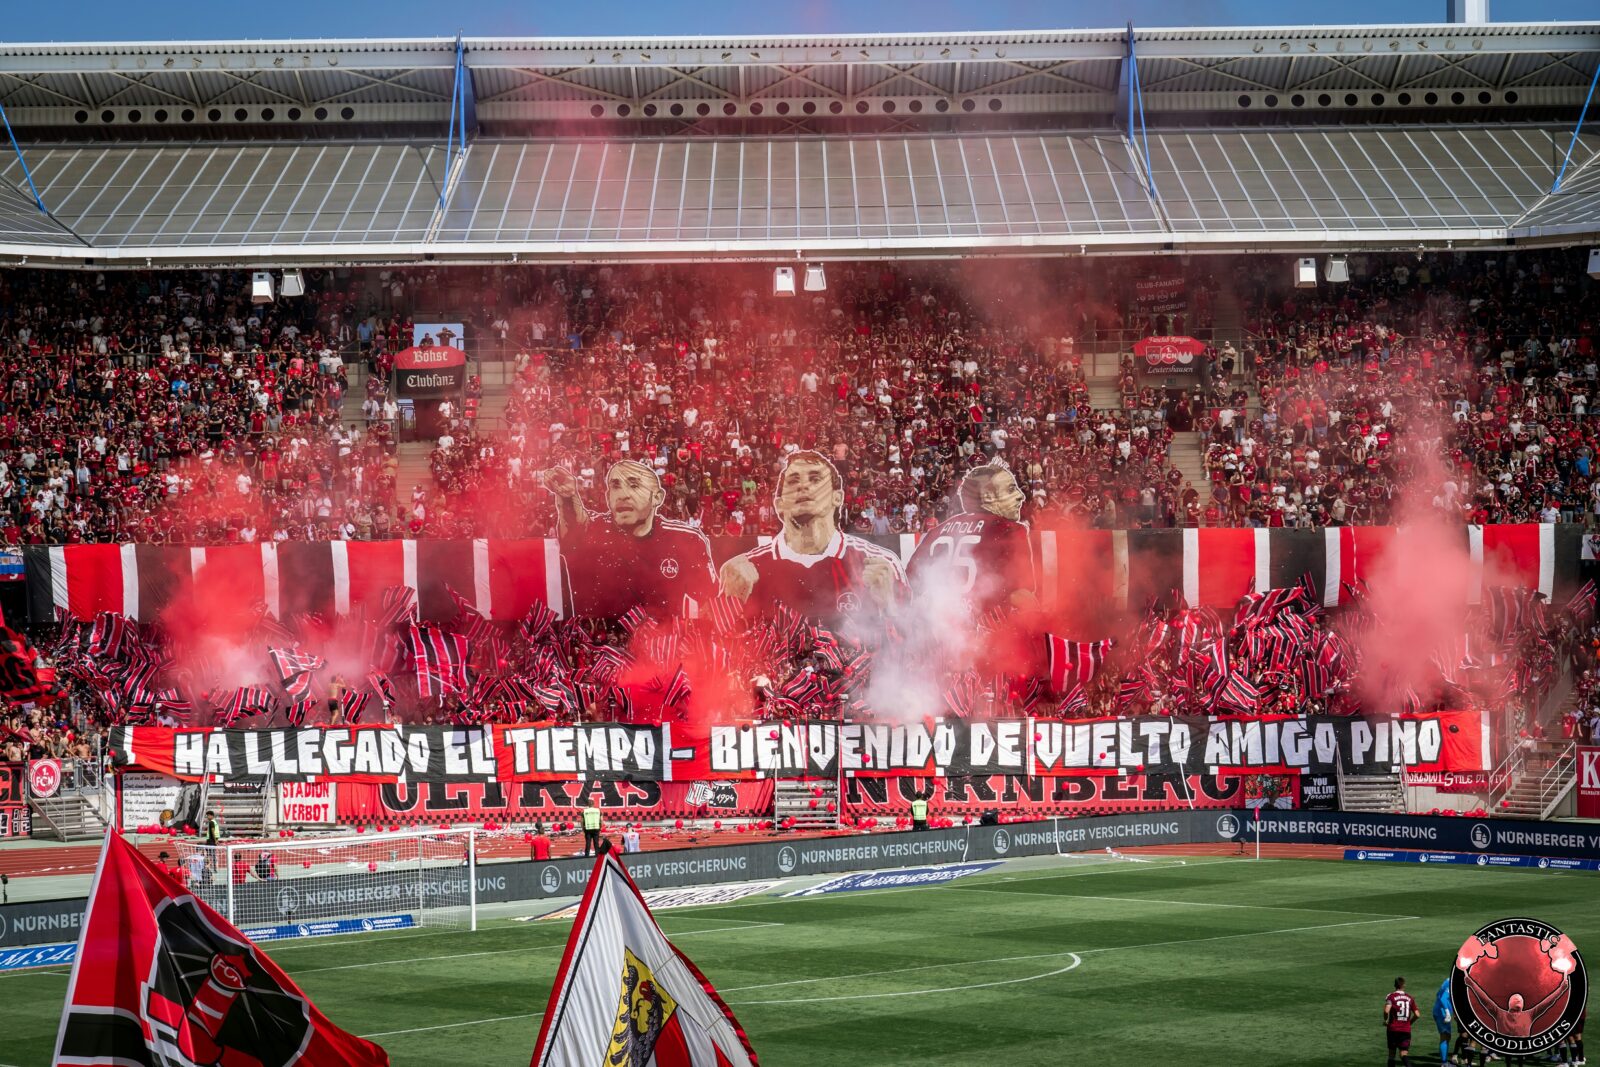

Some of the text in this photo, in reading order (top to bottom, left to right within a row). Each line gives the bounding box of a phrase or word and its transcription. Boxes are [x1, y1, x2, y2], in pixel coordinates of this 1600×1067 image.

[413, 350, 448, 363] Böhse
[661, 566, 679, 574] FCN
[176, 733, 232, 775] HA
[245, 730, 431, 775] LLEGADO
[443, 728, 496, 774] EL
[506, 728, 655, 773] TIEMPO
[711, 724, 955, 770] BIENVENIDO
[971, 722, 1022, 766] DE
[1036, 721, 1191, 768] VUELTO
[1204, 722, 1337, 765] AMIGO
[1351, 719, 1441, 766] PINO
[36, 775, 54, 787] FCN
[282, 781, 329, 798] STADION
[1303, 785, 1321, 795] WILL
[1312, 777, 1328, 786] YOU
[716, 793, 735, 803] 1994
[283, 803, 329, 822] VERBOT
[1014, 821, 1179, 847] NÜRNBERGER VERSICHERUNG
[1246, 820, 1437, 840] NÜRNBERGER VERSICHERUNG
[1496, 830, 1585, 848] NÜRNBERGER
[801, 838, 965, 865] NÜRNBERGER VERSICHERUNG
[655, 856, 747, 877] VERSICHERUNG
[1396, 1000, 1410, 1018] 31
